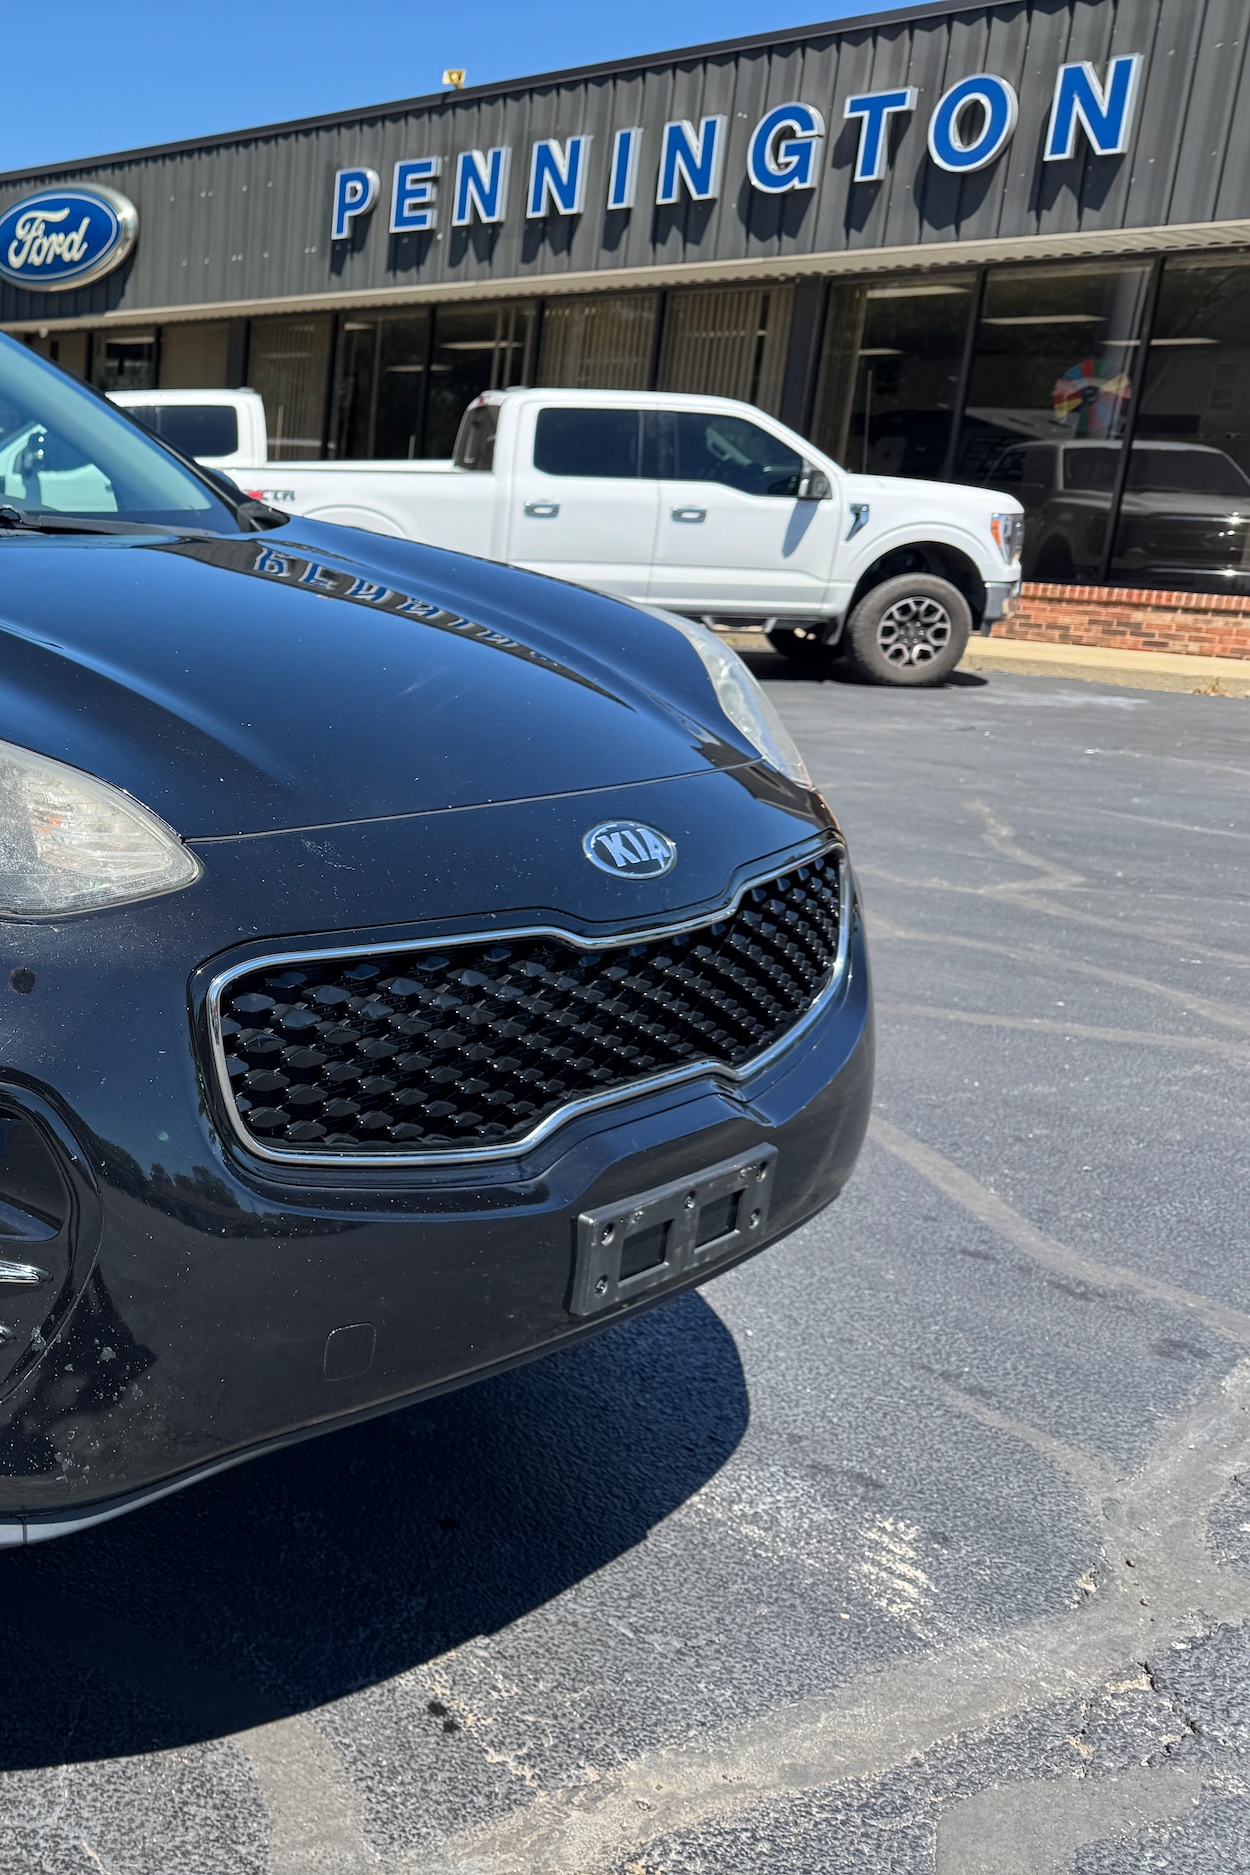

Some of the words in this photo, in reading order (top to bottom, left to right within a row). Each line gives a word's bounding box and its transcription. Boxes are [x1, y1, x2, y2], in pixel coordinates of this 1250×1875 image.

[331, 52, 1145, 240] PENNINGTON
[8, 206, 91, 269] Ford
[597, 828, 670, 868] KIA
